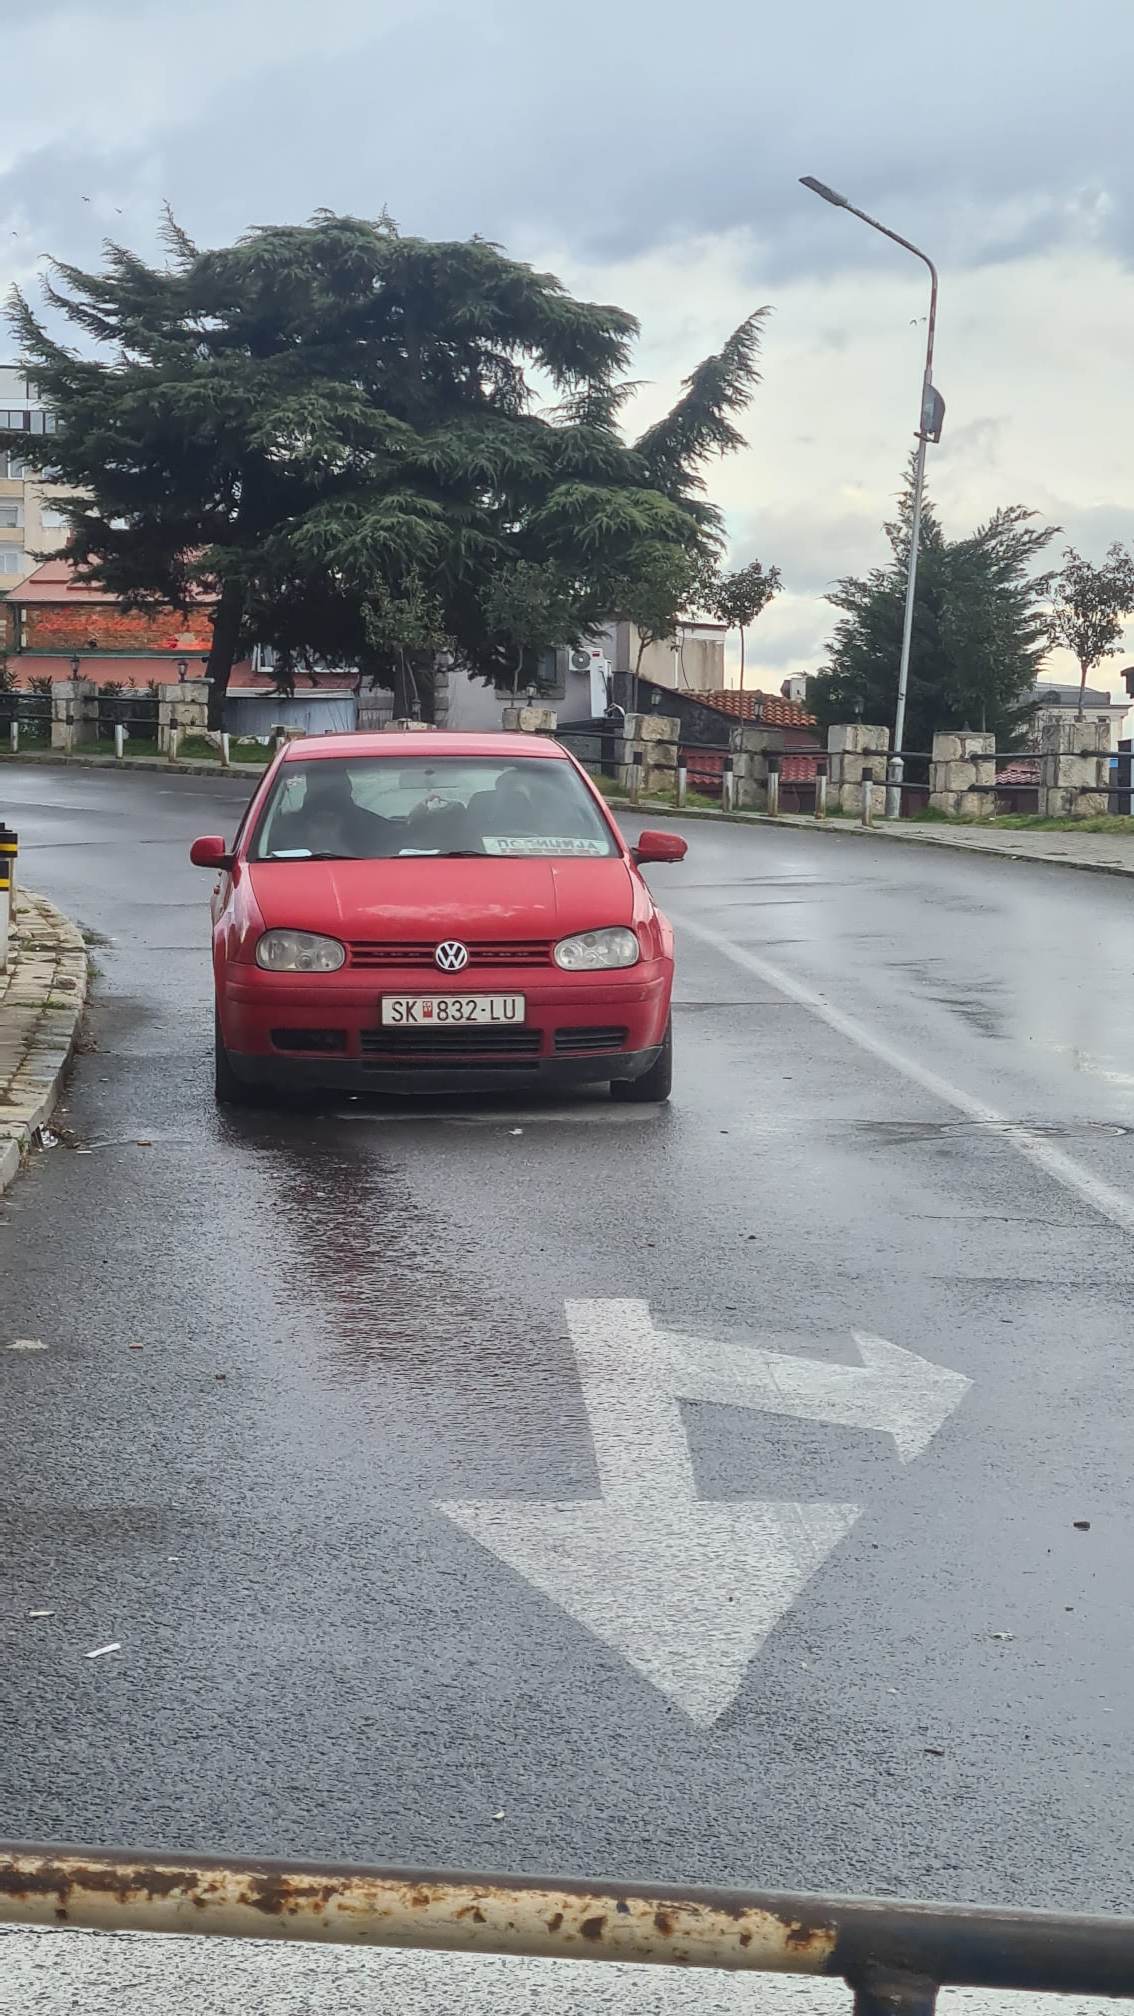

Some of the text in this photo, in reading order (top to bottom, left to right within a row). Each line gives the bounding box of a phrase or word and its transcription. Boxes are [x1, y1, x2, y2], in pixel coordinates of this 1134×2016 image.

[435, 941, 467, 970] VW
[391, 999, 516, 1023] SK 832-LU
